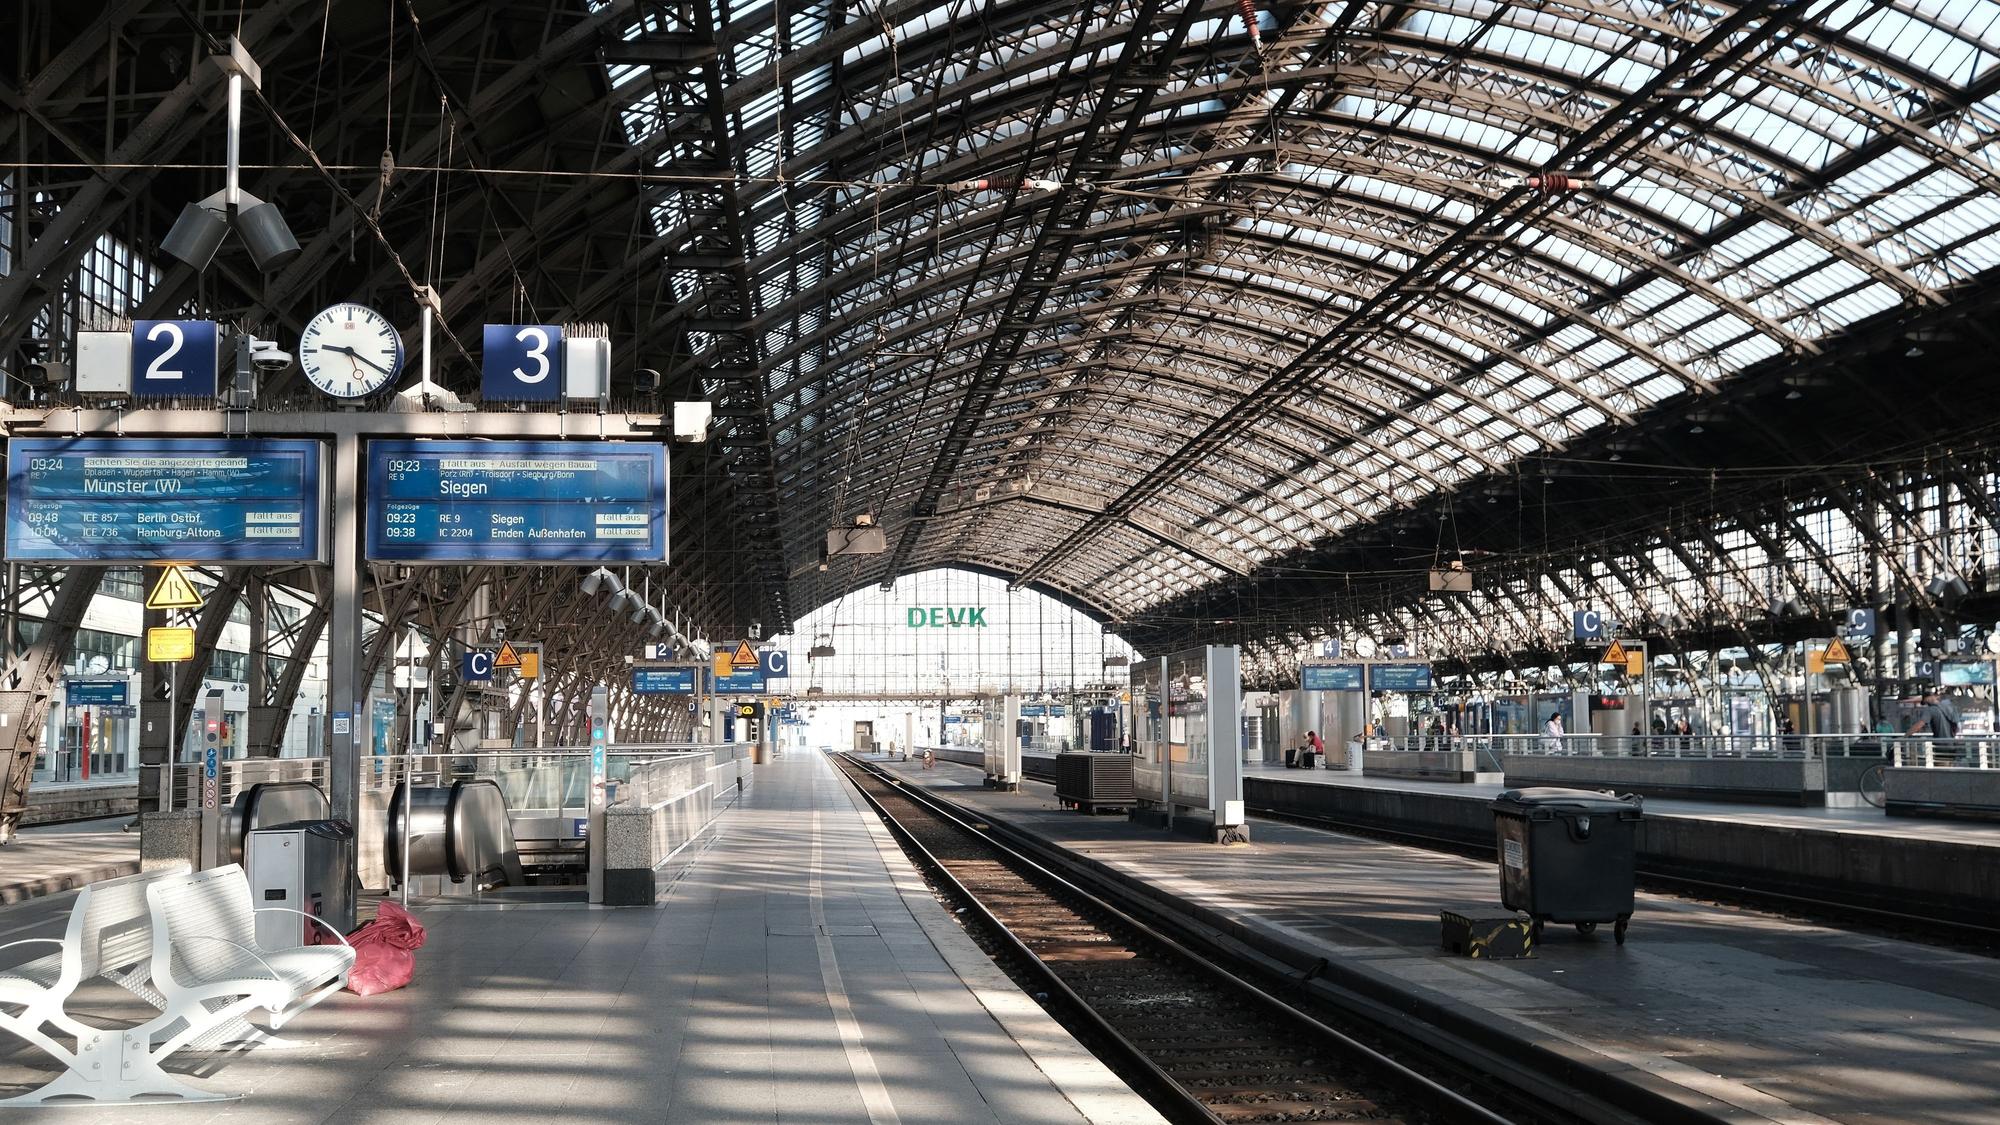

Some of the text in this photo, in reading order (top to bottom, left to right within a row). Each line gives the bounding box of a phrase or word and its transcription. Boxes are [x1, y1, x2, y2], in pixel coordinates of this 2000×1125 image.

[145, 322, 184, 380] 2
[511, 327, 550, 384] 3
[31, 458, 64, 471] 09:24
[388, 460, 420, 472] 09:23
[499, 460, 531, 468] Ausfall
[84, 469, 117, 478] Opladen
[123, 469, 164, 478] Wuppertal
[171, 469, 196, 478] Hagen
[202, 469, 224, 477] Hamm
[440, 470, 457, 478] Porz
[482, 470, 515, 478] Troisdorf
[522, 470, 575, 480] Siegburg/Bonn
[84, 478, 181, 495] Münster (W)
[440, 479, 488, 498] Siegen
[28, 512, 59, 523] 09:48
[83, 513, 98, 522] ICE
[101, 513, 119, 522] 857
[137, 512, 167, 523] Berlin
[170, 512, 203, 523] Ostbf.
[386, 513, 416, 523] 09:23
[440, 514, 452, 523] RE
[454, 514, 461, 523] 9
[491, 513, 525, 526] Siegen
[83, 527, 98, 537] ICE
[101, 527, 118, 537] 736
[137, 527, 221, 540] Hamburg-Altona
[386, 527, 416, 538] 09:38
[440, 528, 448, 537] IC
[451, 528, 473, 538] 2204
[491, 528, 524, 538] Emden
[528, 527, 586, 539] Außenhafen
[907, 606, 988, 628] DEVK
[1583, 611, 1598, 632] C
[1851, 609, 1867, 630] C
[658, 642, 667, 656] 2
[1324, 642, 1334, 654] 4
[471, 653, 488, 675] C
[767, 651, 784, 673] C
[1922, 661, 1933, 675] C
[688, 702, 696, 711] D
[789, 702, 796, 711] D
[1109, 698, 1115, 706] D
